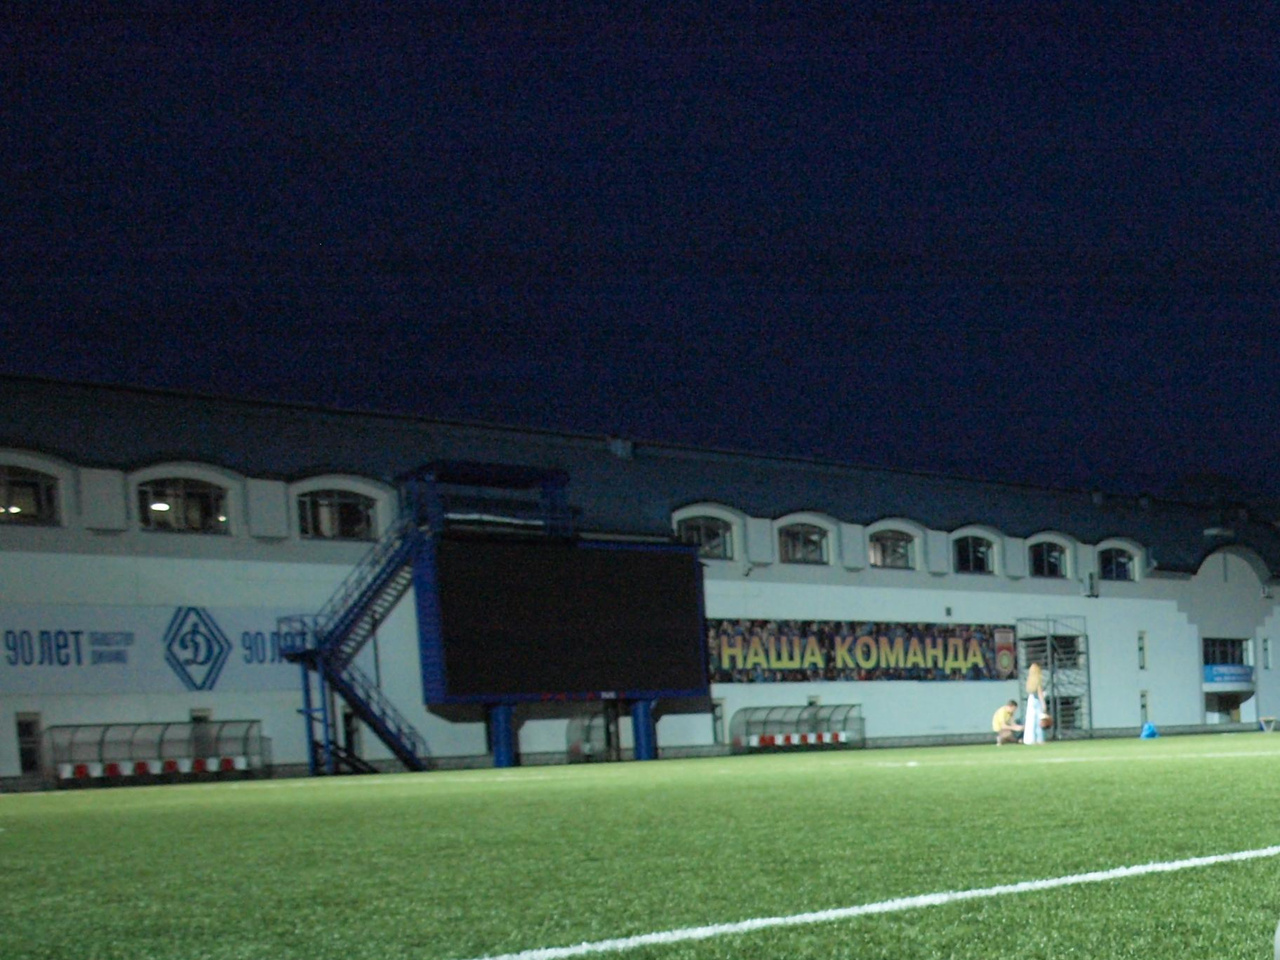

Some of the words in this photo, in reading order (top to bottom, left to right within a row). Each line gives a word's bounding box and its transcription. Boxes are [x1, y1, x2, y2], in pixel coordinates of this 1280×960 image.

[5, 630, 33, 665] 90
[242, 631, 266, 664] 90
[721, 636, 824, 669] НАША
[835, 636, 984, 673] КОМАНДА
